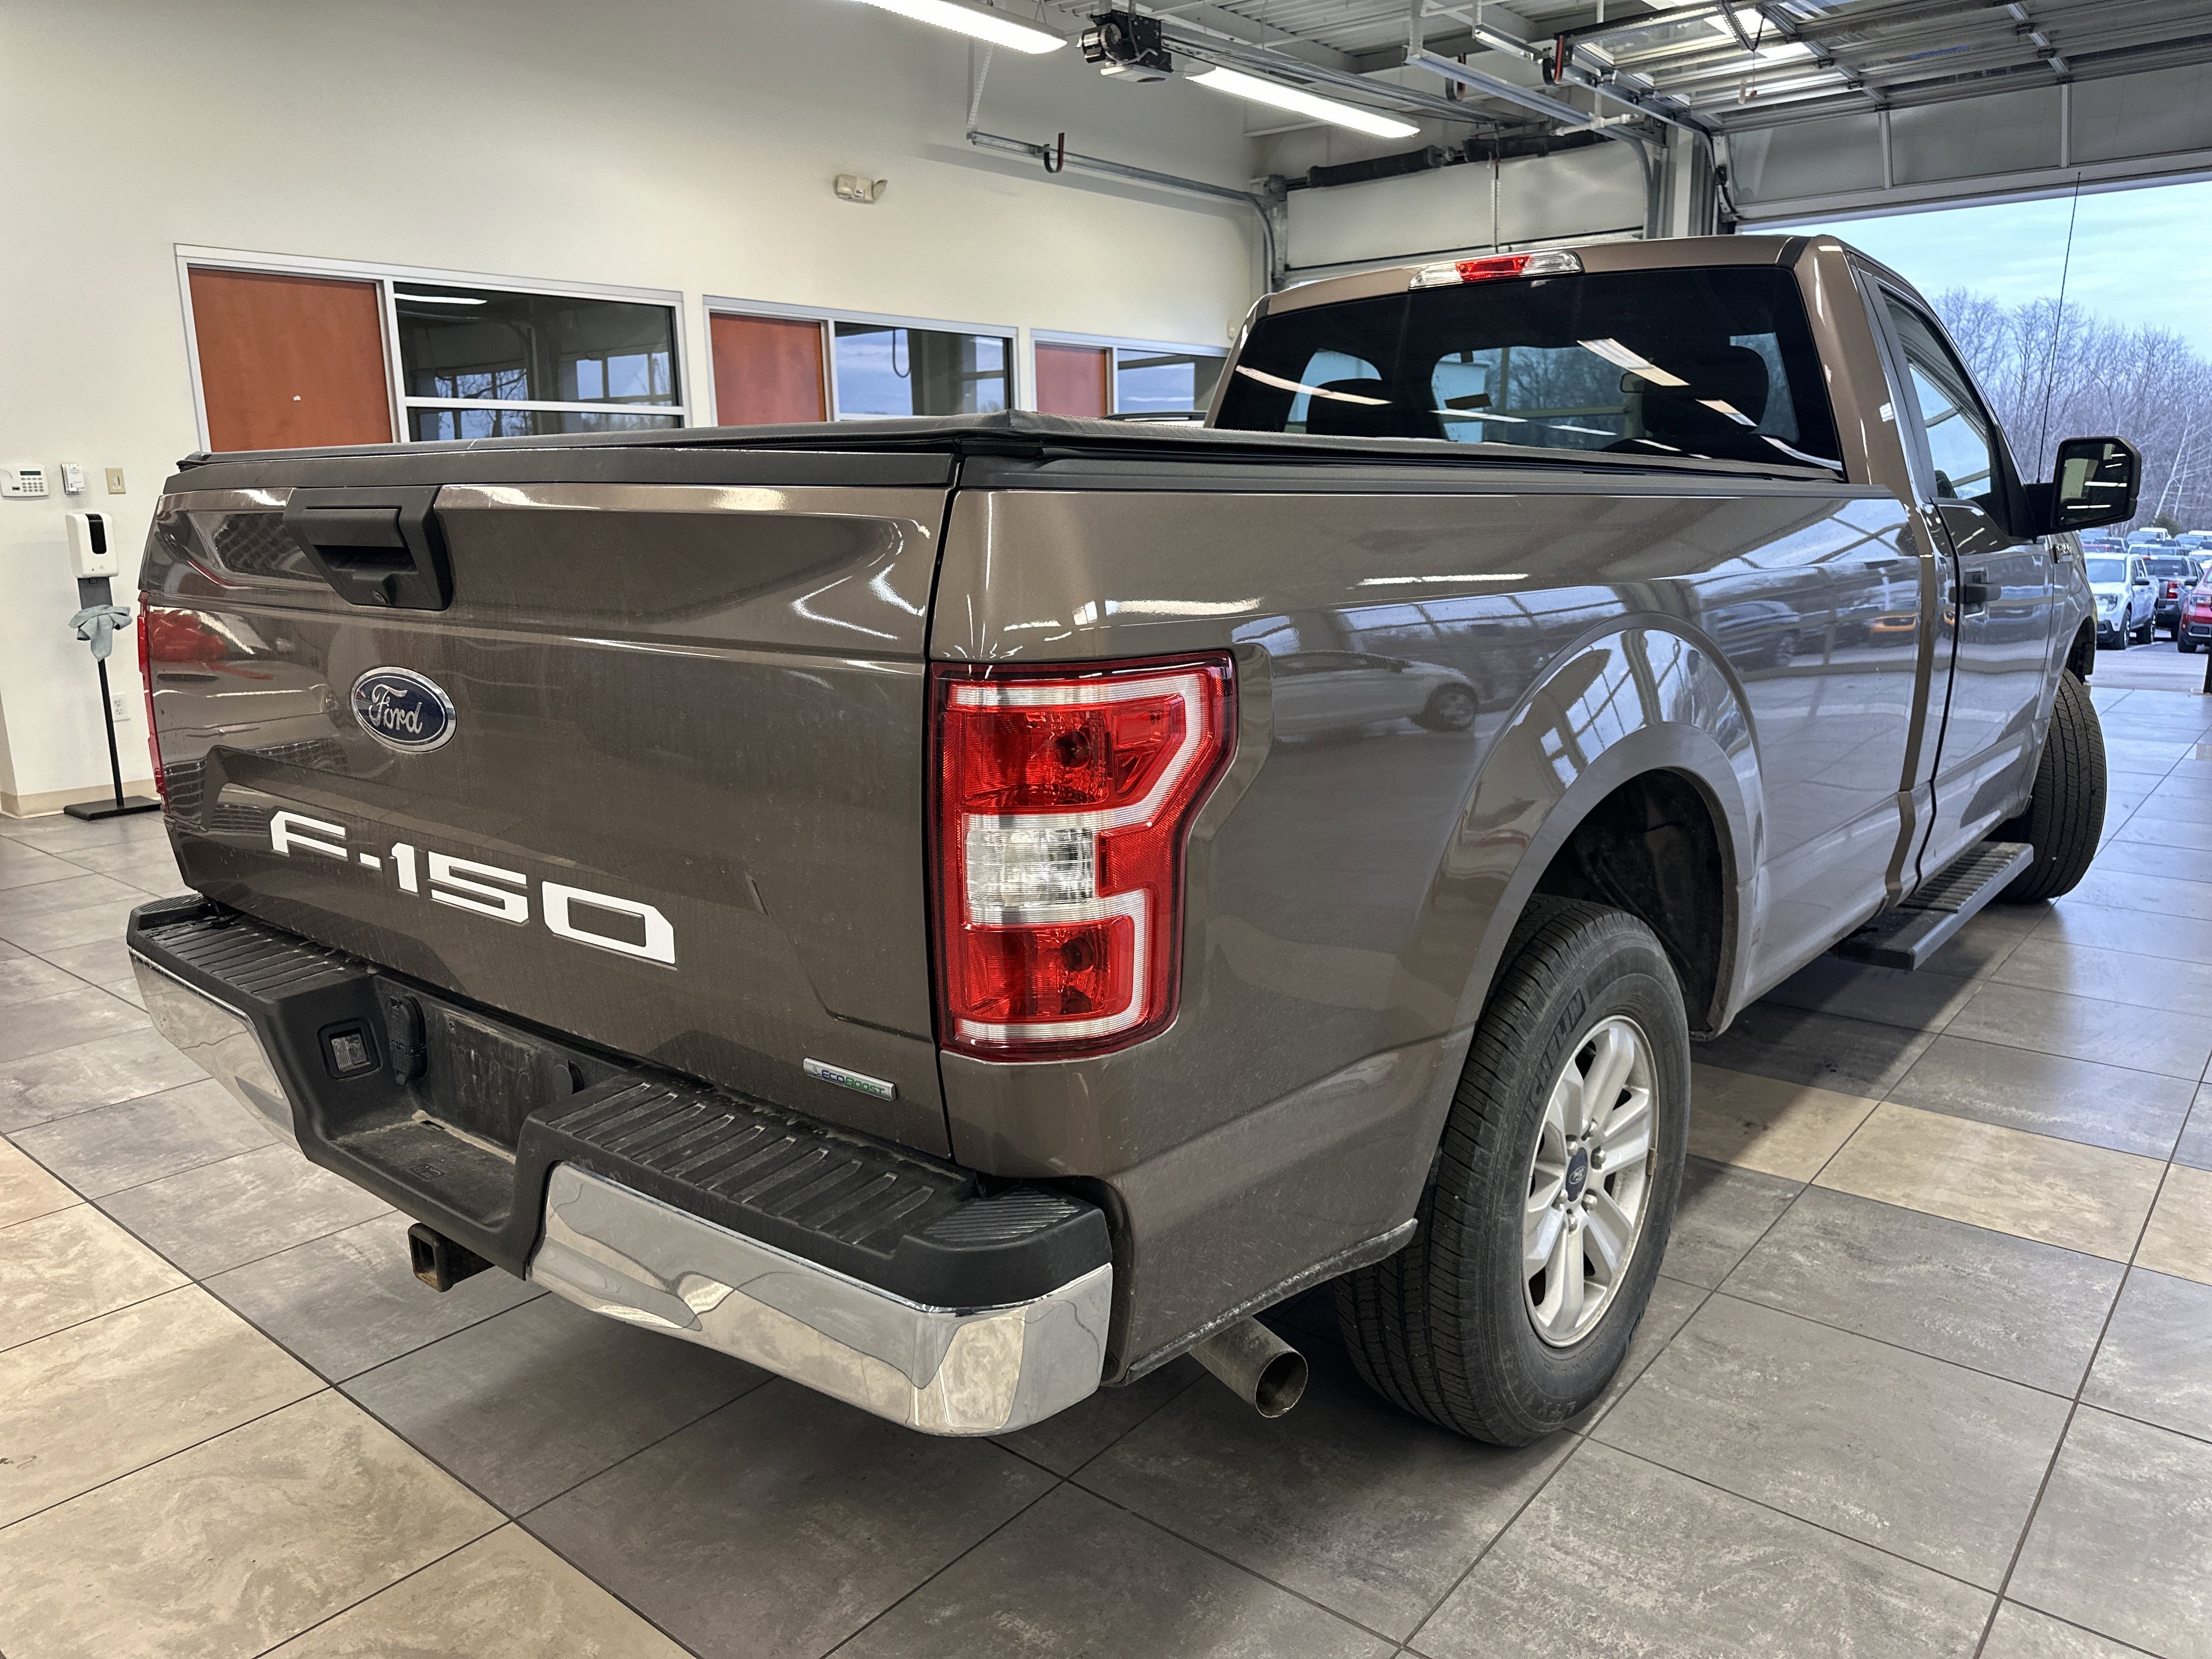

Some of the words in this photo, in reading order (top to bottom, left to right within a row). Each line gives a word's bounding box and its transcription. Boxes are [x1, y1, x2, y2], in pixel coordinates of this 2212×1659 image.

[369, 684, 423, 734] Ford
[270, 810, 676, 964] F-150
[821, 1070, 885, 1094] ECOBOOST
[1514, 989, 1584, 1154] MICHELIN
